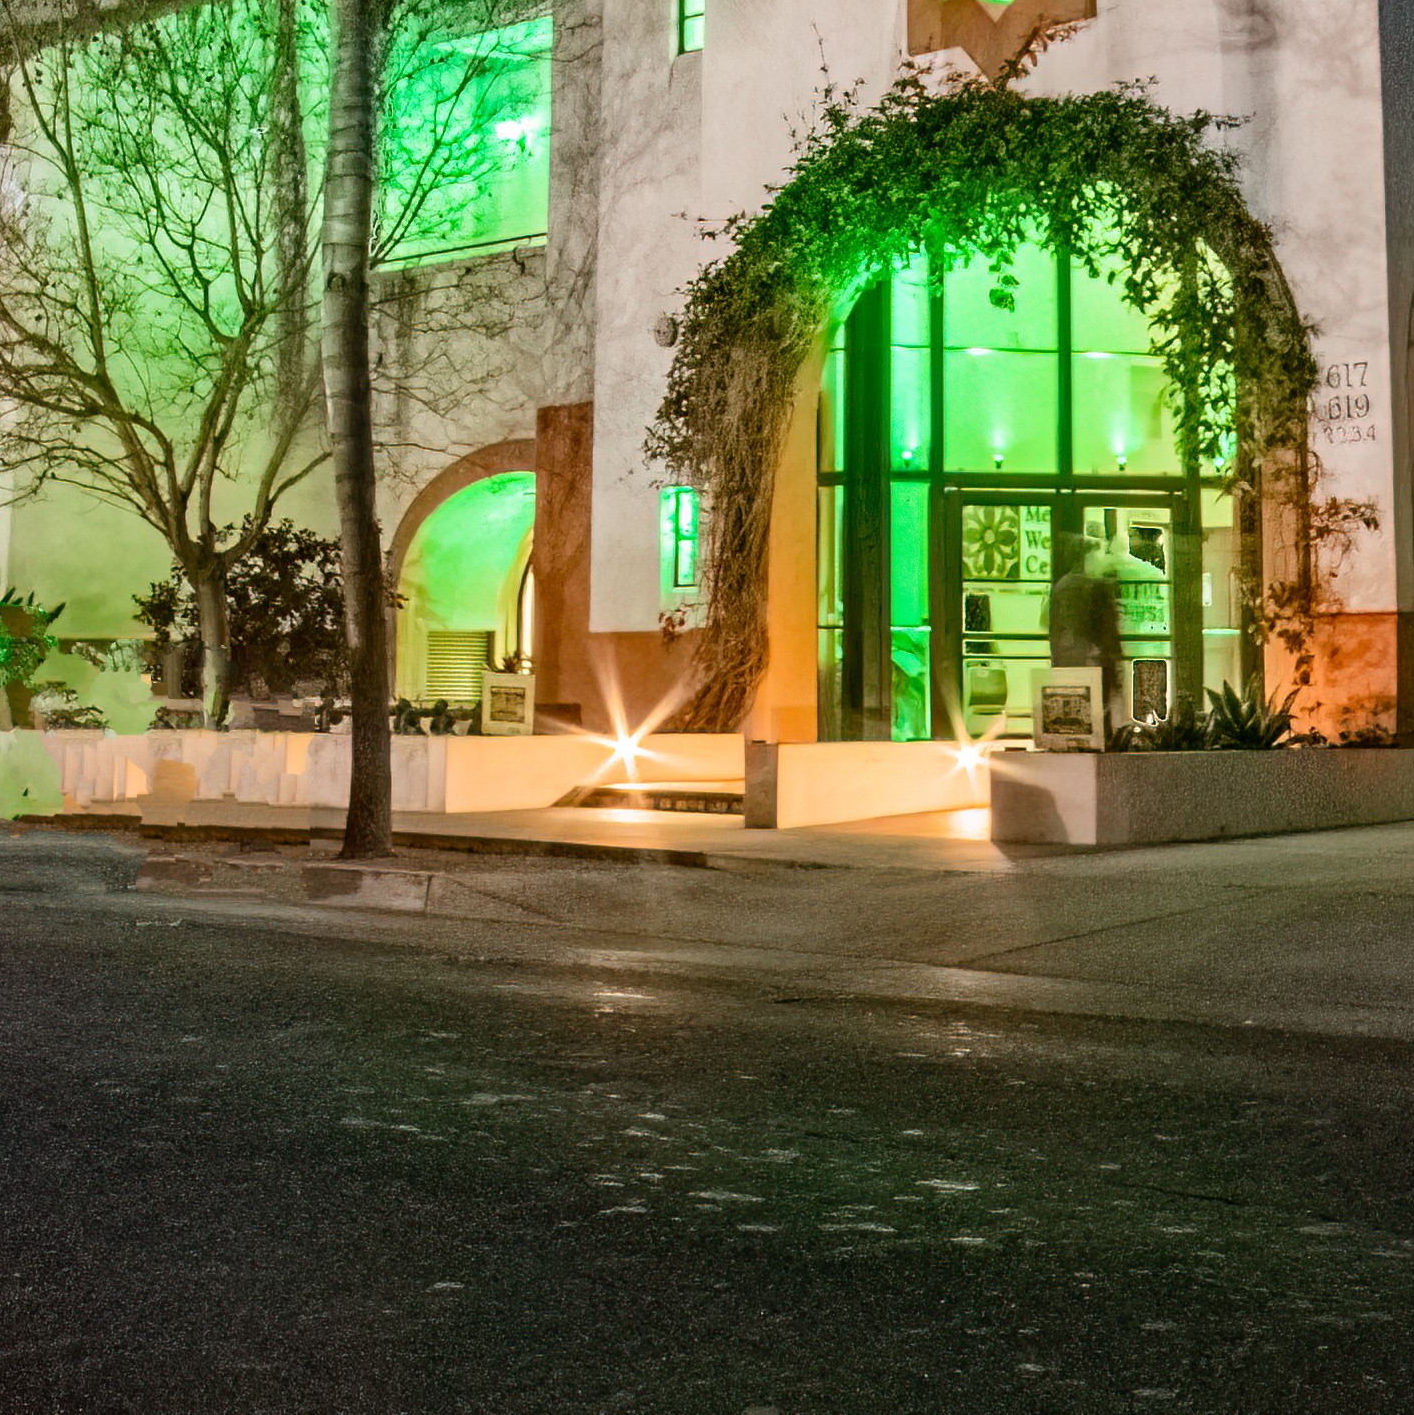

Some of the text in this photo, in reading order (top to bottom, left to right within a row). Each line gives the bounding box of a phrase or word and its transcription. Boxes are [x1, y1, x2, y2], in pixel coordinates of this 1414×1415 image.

[1326, 361, 1369, 389] 617
[1328, 394, 1370, 420] 619
[1025, 530, 1051, 549] We
[1025, 555, 1050, 574] Ce
